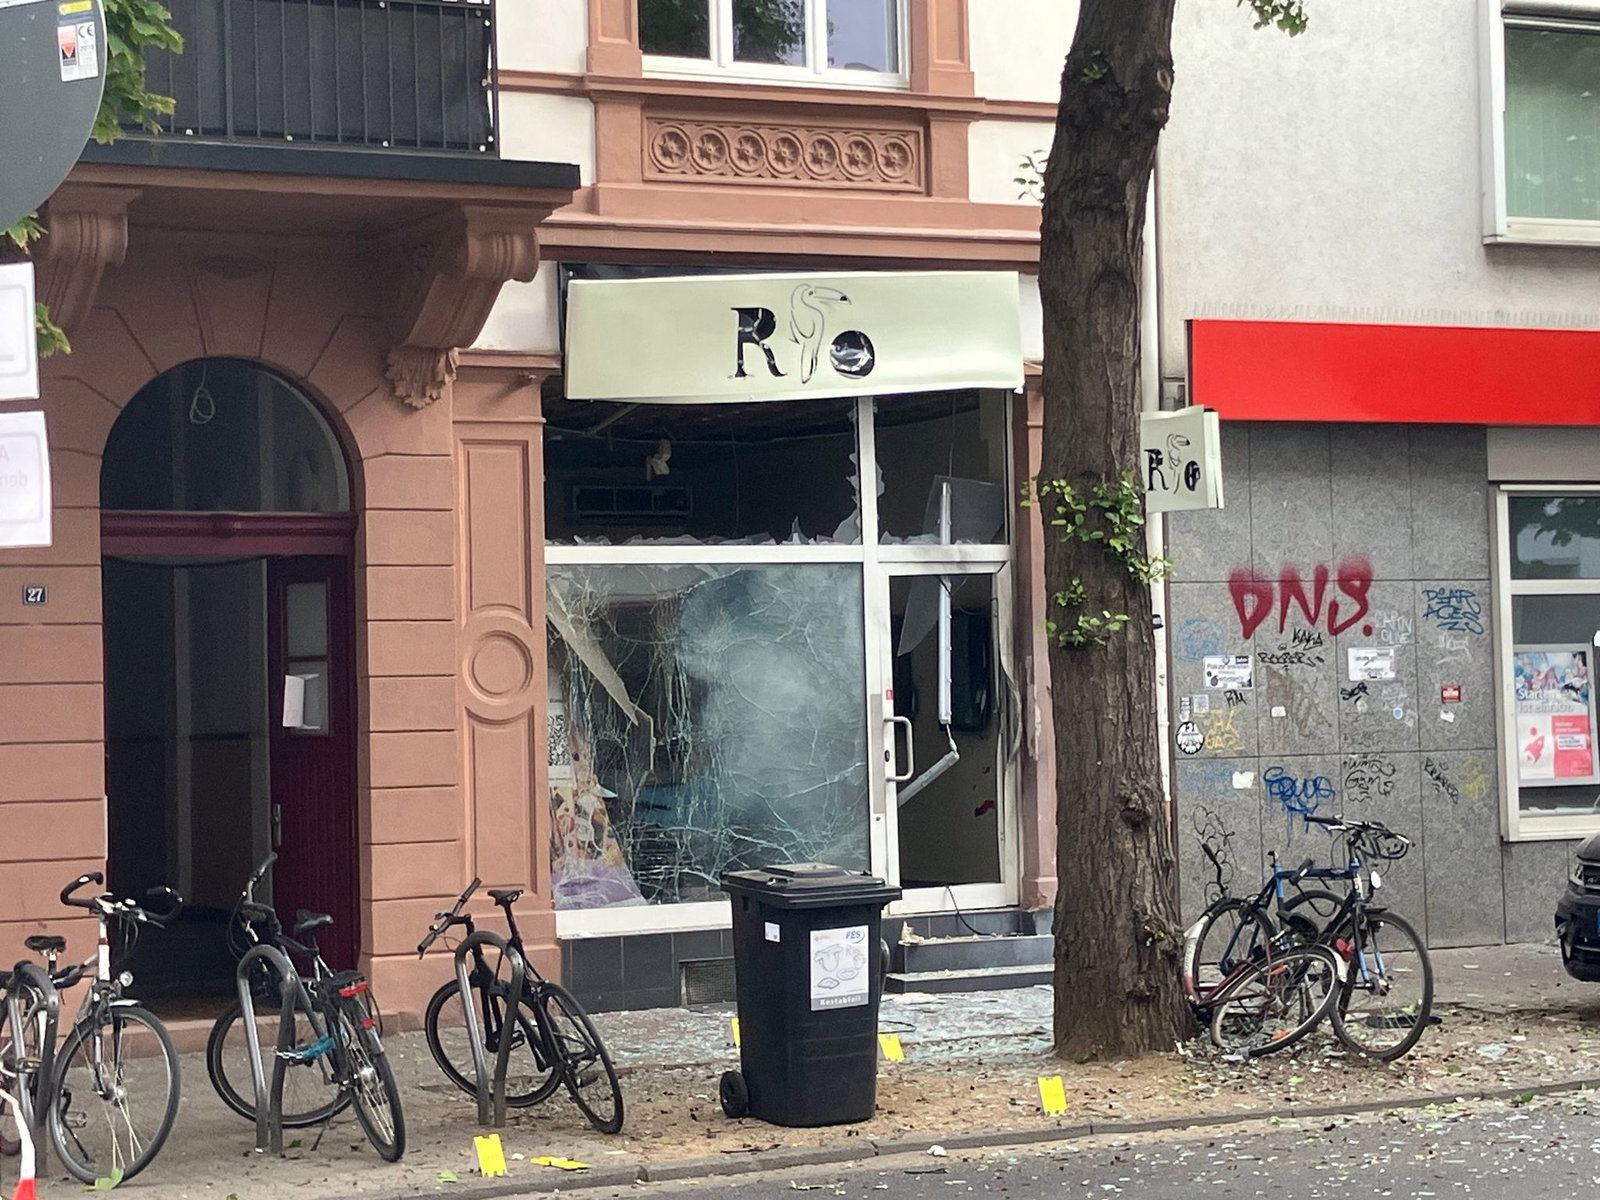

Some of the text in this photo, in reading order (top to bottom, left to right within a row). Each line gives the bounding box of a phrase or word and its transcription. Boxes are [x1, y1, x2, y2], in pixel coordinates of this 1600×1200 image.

[27, 588, 43, 602] 27
[846, 930, 861, 940] FES
[819, 995, 862, 1006] Restabfall
